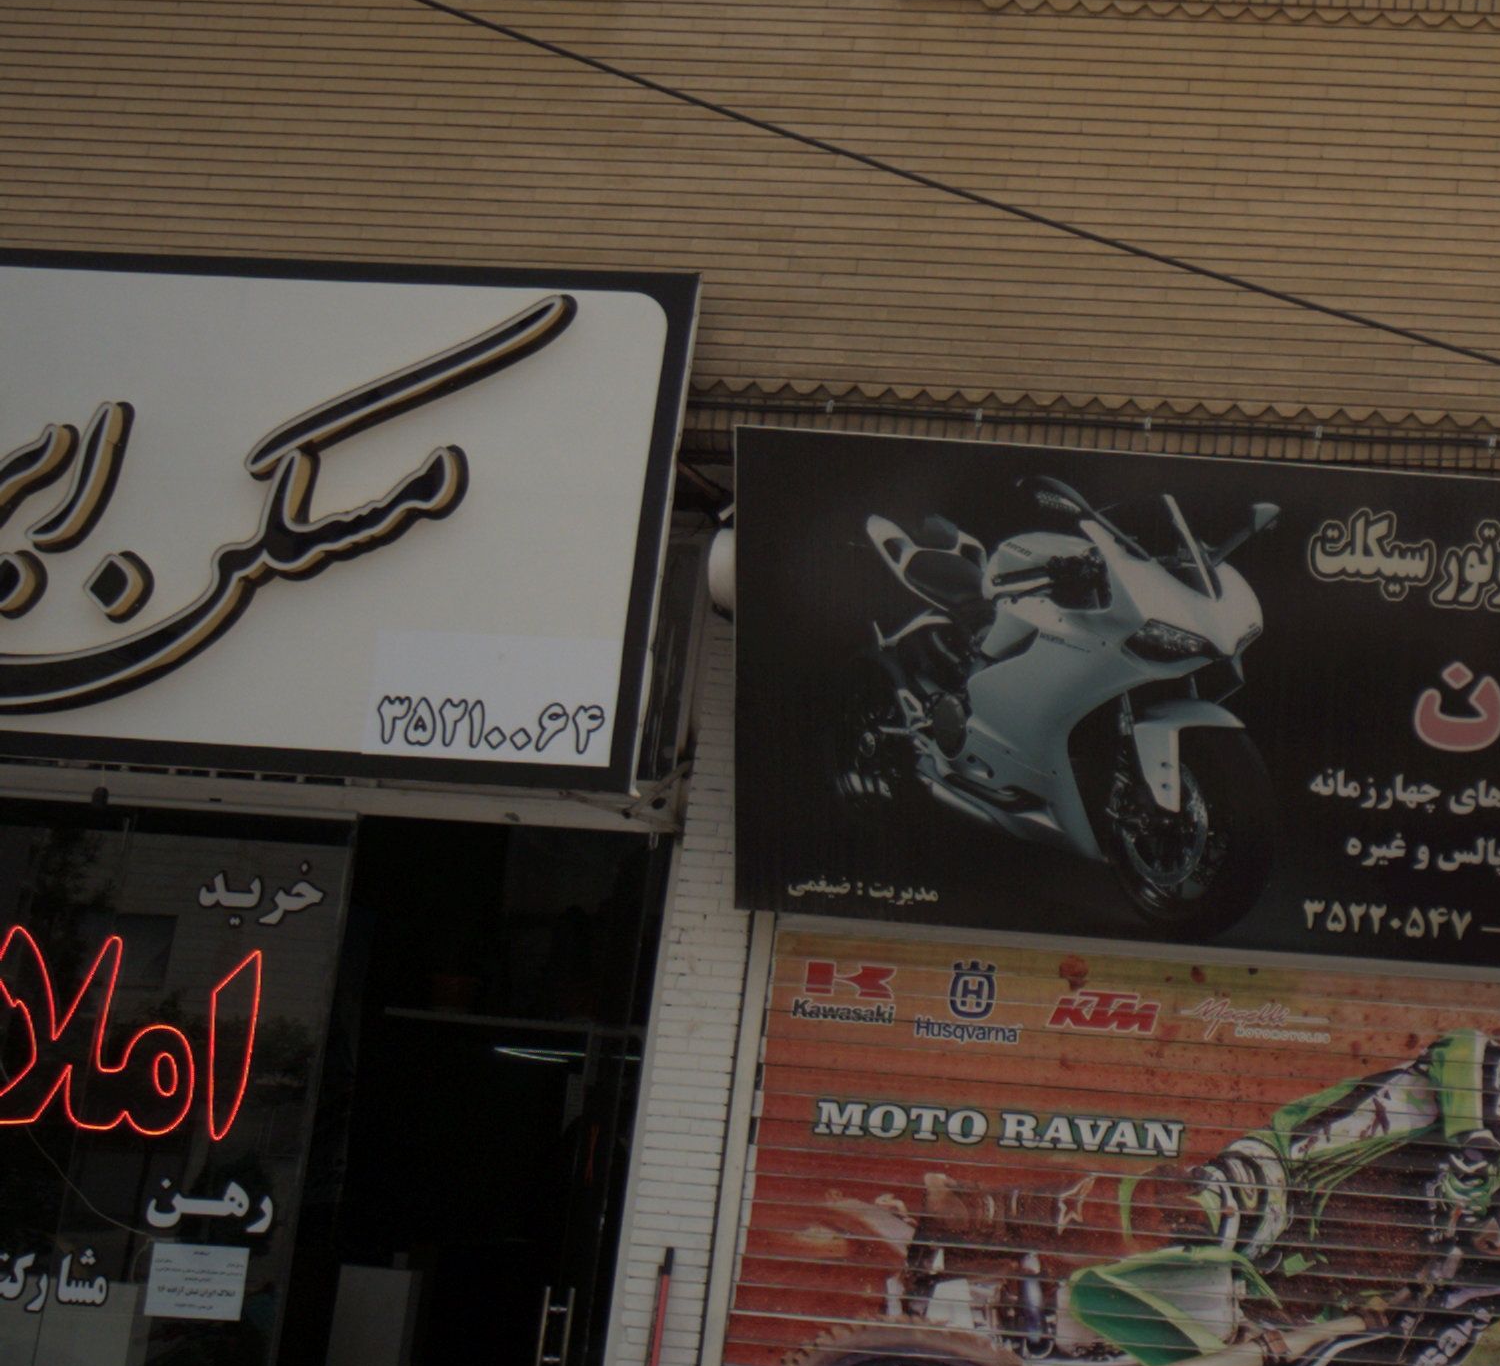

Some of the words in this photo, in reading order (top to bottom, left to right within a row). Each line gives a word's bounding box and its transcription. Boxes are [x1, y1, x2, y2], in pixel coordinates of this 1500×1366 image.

[378, 696, 605, 754] ۳۵۲۱۰۰۶۴
[1346, 832, 1407, 866] غیره
[1413, 844, 1430, 869] و
[198, 861, 325, 927] خرید
[868, 882, 939, 905] مدیریت
[1303, 899, 1473, 940] ۳۵۲۲۰۵۴۷
[792, 999, 894, 1024] Kawasaki
[915, 1018, 1019, 1043] Husqvarna
[1049, 991, 1160, 1033] KTM
[0, 924, 262, 1141] املا
[813, 1100, 988, 1145] MOTO
[997, 1111, 1185, 1158] RAVAN
[146, 1177, 273, 1234] رهن
